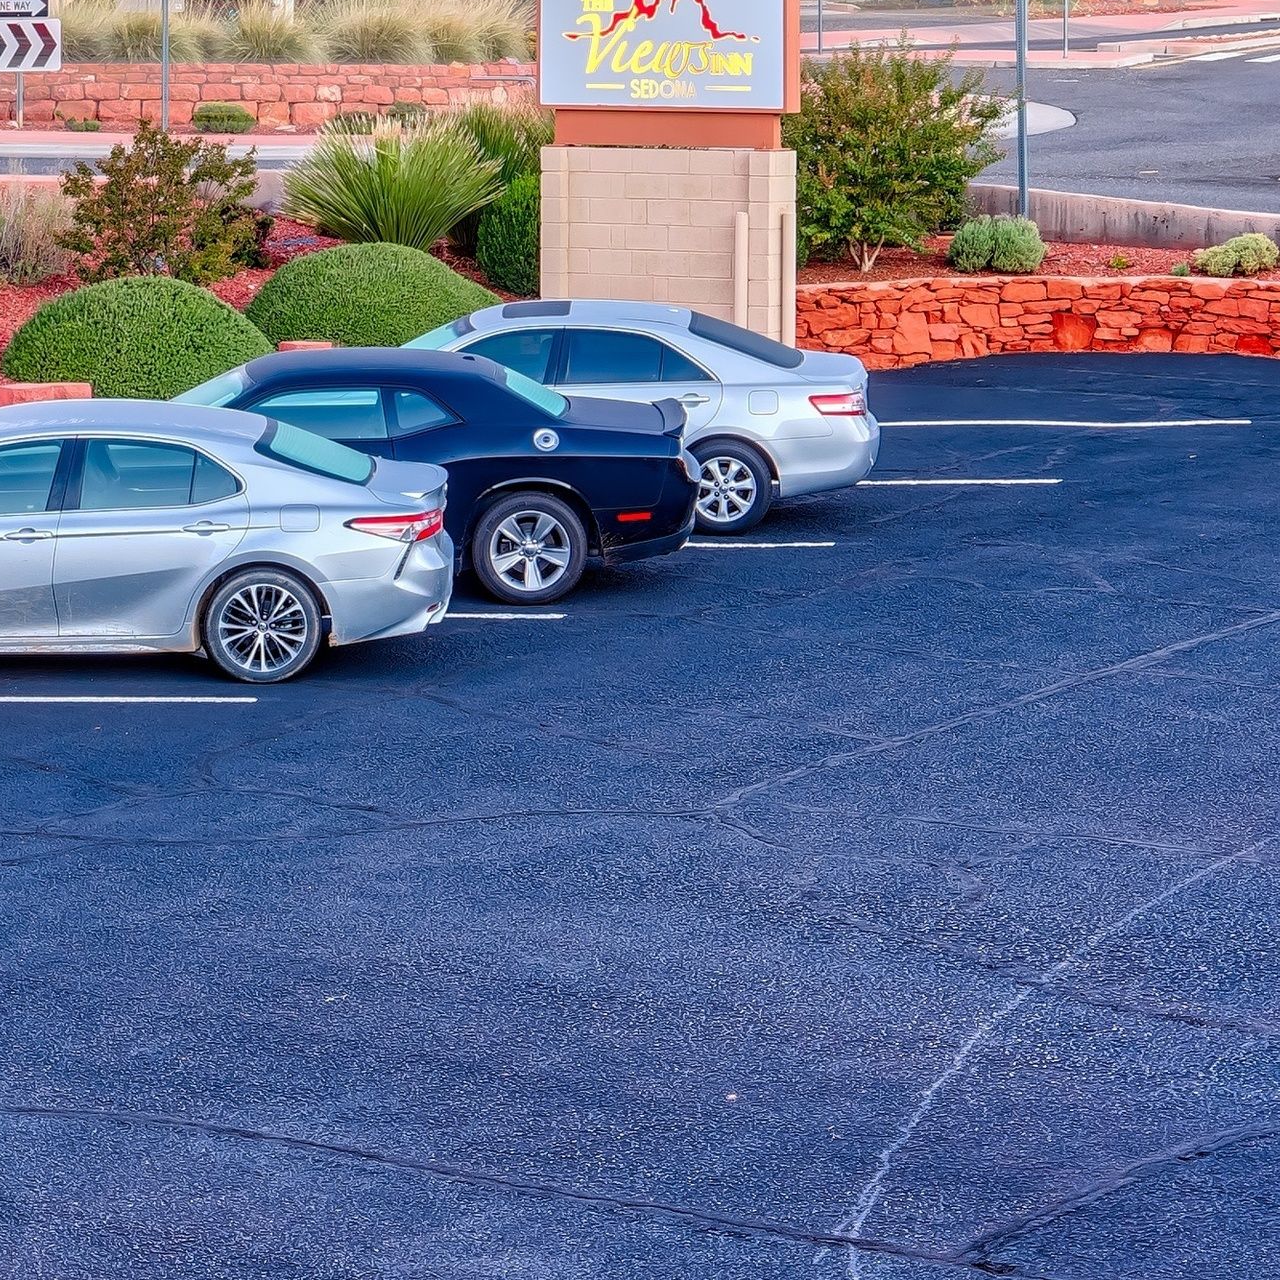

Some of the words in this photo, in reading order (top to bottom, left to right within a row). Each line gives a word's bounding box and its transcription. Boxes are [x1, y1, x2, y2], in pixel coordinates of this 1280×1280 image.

[13, 1, 31, 11] WAY
[575, 4, 714, 79] Views
[710, 51, 754, 77] INN
[630, 78, 698, 100] SEDONA
